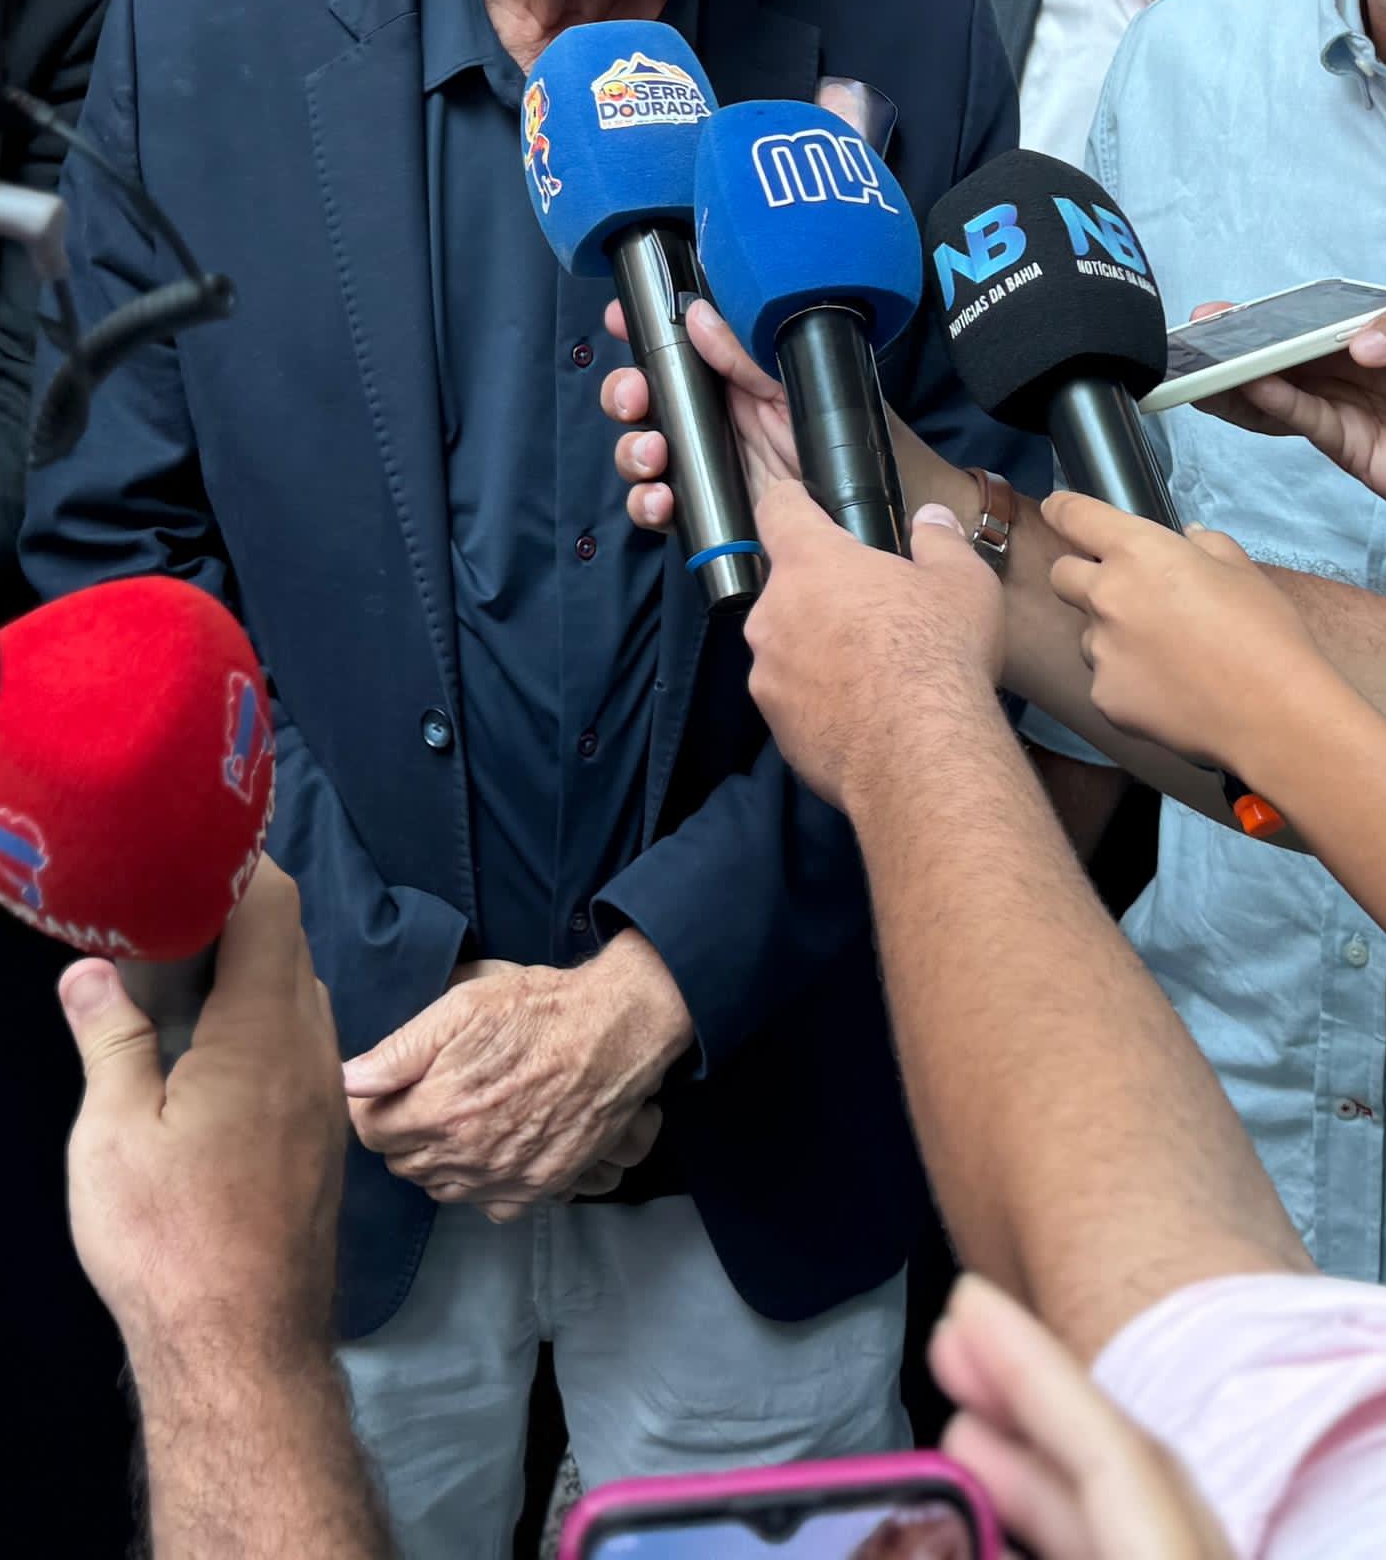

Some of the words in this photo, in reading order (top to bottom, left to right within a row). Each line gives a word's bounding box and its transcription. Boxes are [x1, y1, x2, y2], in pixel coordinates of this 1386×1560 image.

[633, 84, 704, 102] SERRA
[599, 101, 708, 120] DOURADA
[933, 203, 1028, 312] NB
[1076, 259, 1126, 281] NOTÍCIAS
[949, 294, 990, 340] NOTÍCIAS
[988, 283, 1007, 304] DA
[1004, 261, 1044, 293] BAHIA
